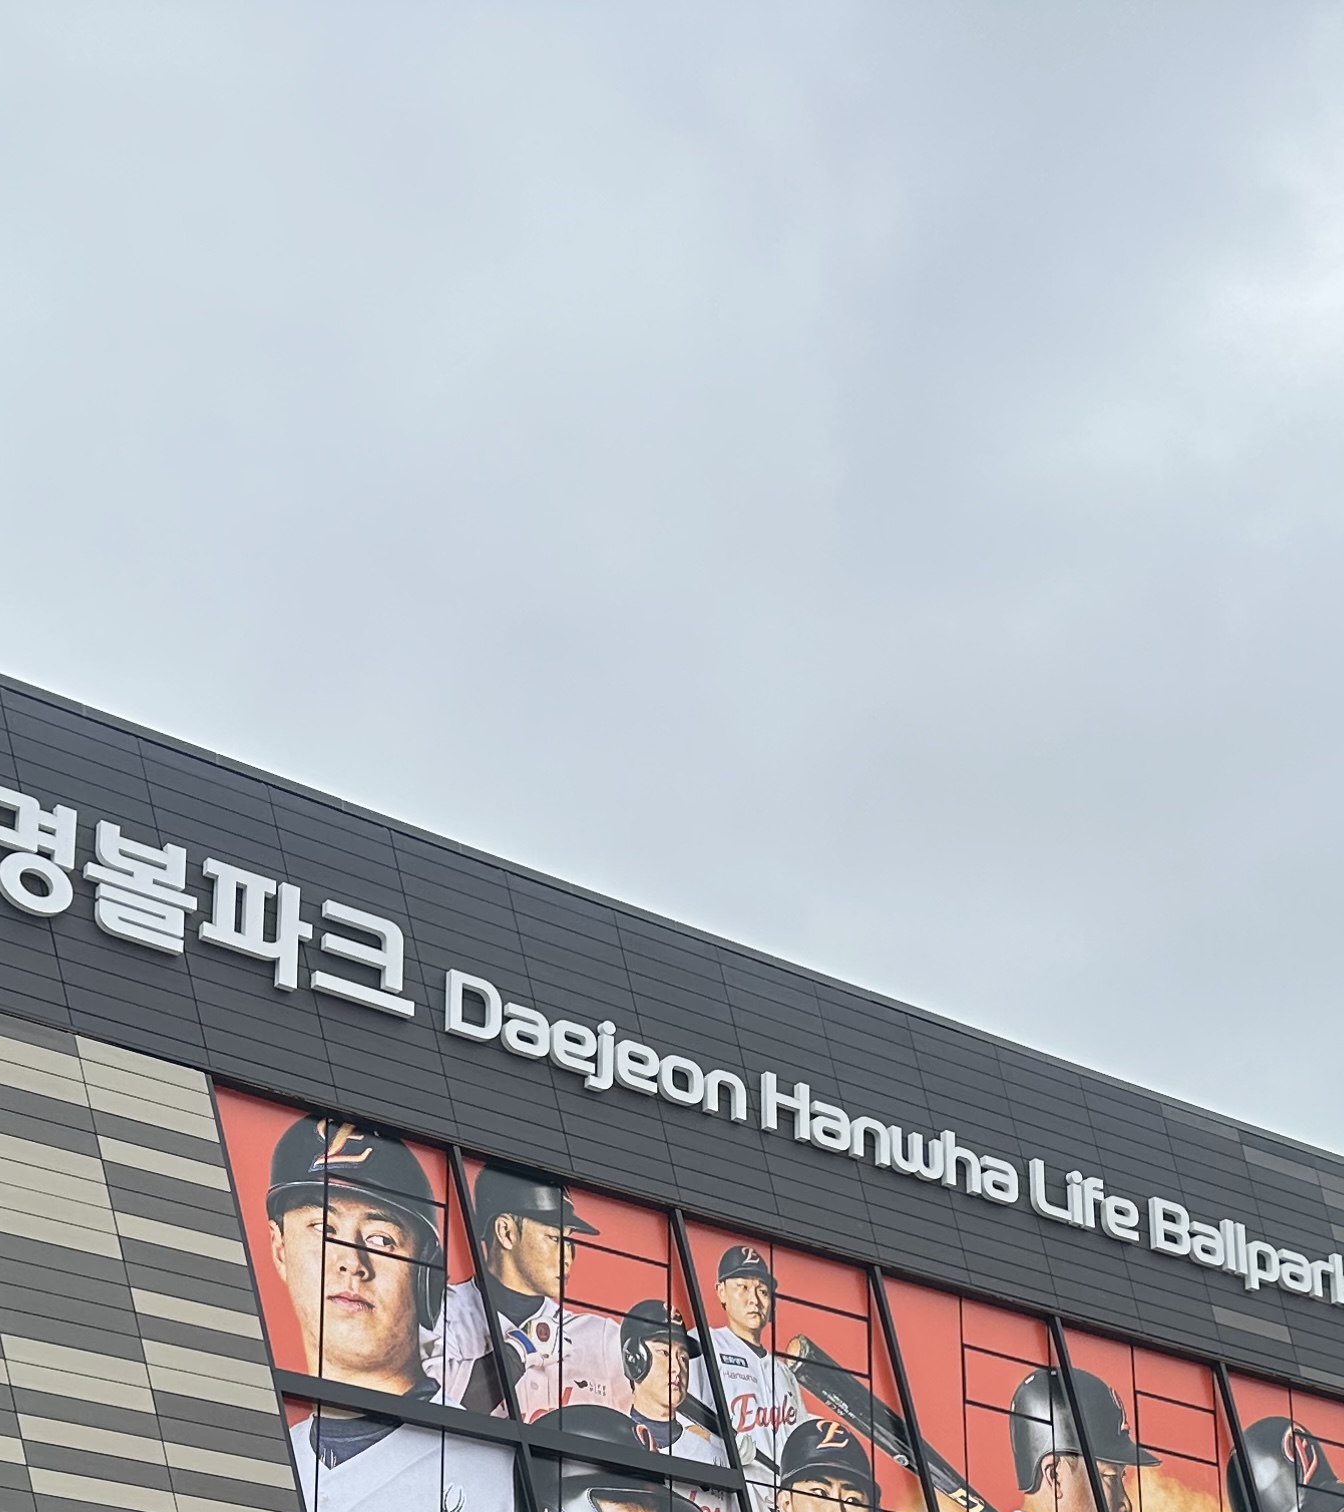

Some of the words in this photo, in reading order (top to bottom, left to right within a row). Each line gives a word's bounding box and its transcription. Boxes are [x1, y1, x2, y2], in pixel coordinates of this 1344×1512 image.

[444, 969, 748, 1123] Daejeon
[759, 1071, 1019, 1205] Hanwha
[1029, 1158, 1141, 1244] Life
